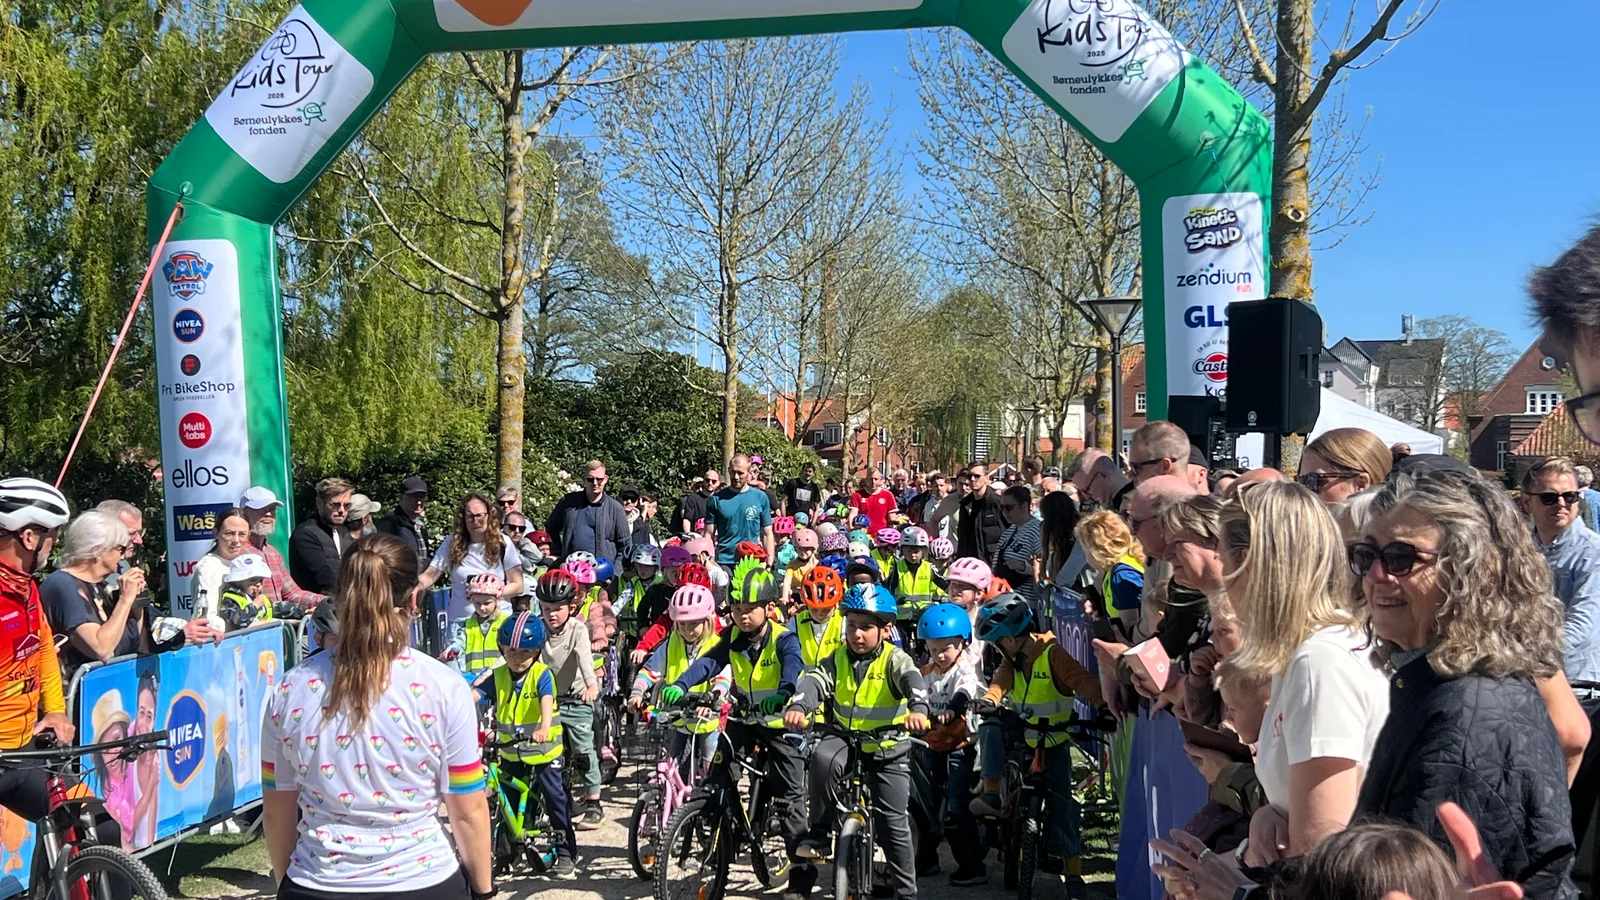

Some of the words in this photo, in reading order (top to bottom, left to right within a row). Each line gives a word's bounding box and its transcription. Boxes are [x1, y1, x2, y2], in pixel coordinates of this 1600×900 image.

[1036, 13, 1107, 54] Kids
[284, 55, 333, 93] Tour
[1052, 73, 1123, 85] Børneulykkes
[1069, 86, 1106, 94] fonden
[233, 115, 302, 127] Børneulykkes
[249, 126, 286, 136] fonden
[1185, 209, 1237, 230] Kinetic
[162, 258, 214, 282] PAW
[1176, 268, 1252, 288] zendium
[172, 283, 201, 292] PATROL
[175, 319, 202, 329] NIVEA
[1183, 304, 1229, 329] GL
[180, 327, 196, 336] SUN
[161, 383, 173, 396] Fri
[175, 380, 236, 394] BikeShop
[183, 421, 205, 432] Multi
[172, 459, 229, 488] ellos
[169, 721, 203, 748] NIVEA
